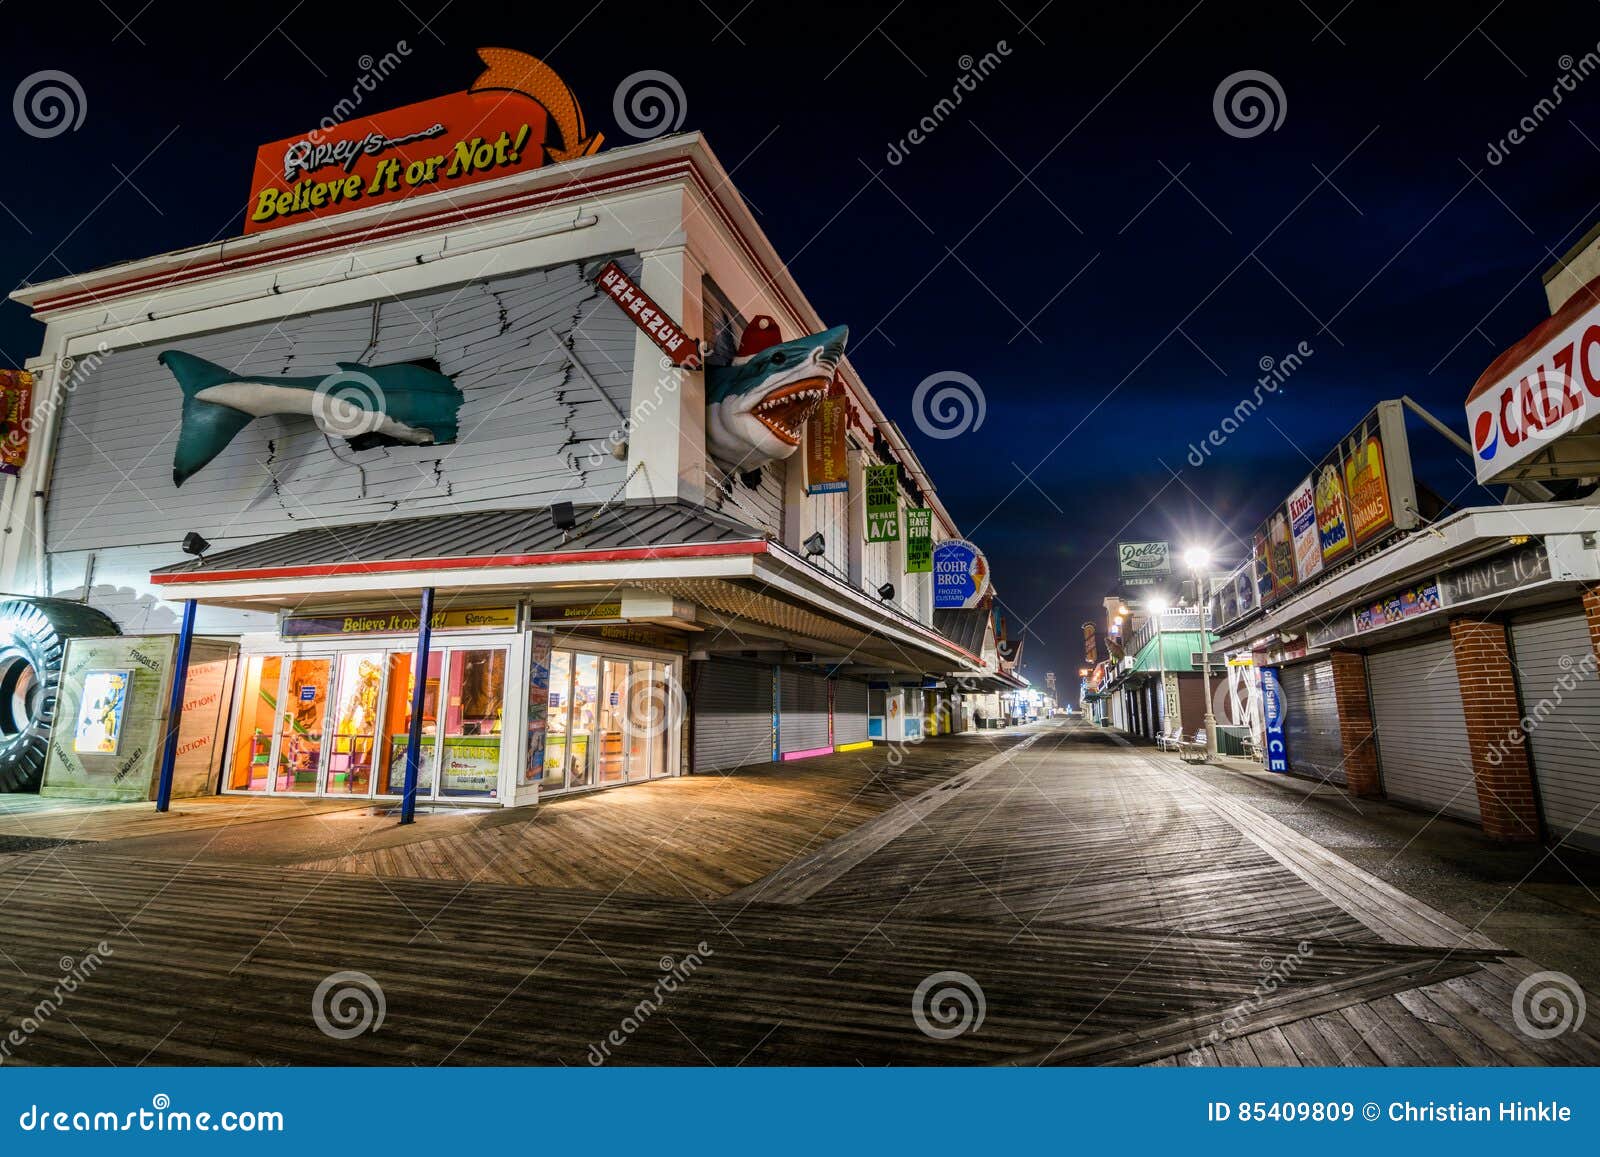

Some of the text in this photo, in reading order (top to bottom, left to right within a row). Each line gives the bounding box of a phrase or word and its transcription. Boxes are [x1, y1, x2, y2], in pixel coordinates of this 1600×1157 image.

[251, 123, 529, 221] Believe It or Not!
[602, 270, 684, 352] ENTRANCE
[869, 511, 897, 520] WE HAVE
[909, 518, 929, 526] HAVE
[870, 520, 897, 539] A/C
[910, 527, 929, 538] FUN
[936, 561, 969, 573] KOHR
[937, 574, 967, 585] BROS
[342, 616, 386, 633] Believe
[387, 615, 400, 631] It
[402, 617, 417, 630] or
[130, 649, 160, 672] FRAGILE!
[1264, 671, 1276, 719] CRUSHED
[53, 743, 75, 773] FRAGILE!
[1268, 726, 1285, 770] ICE
[113, 748, 143, 785] FRAGILE!
